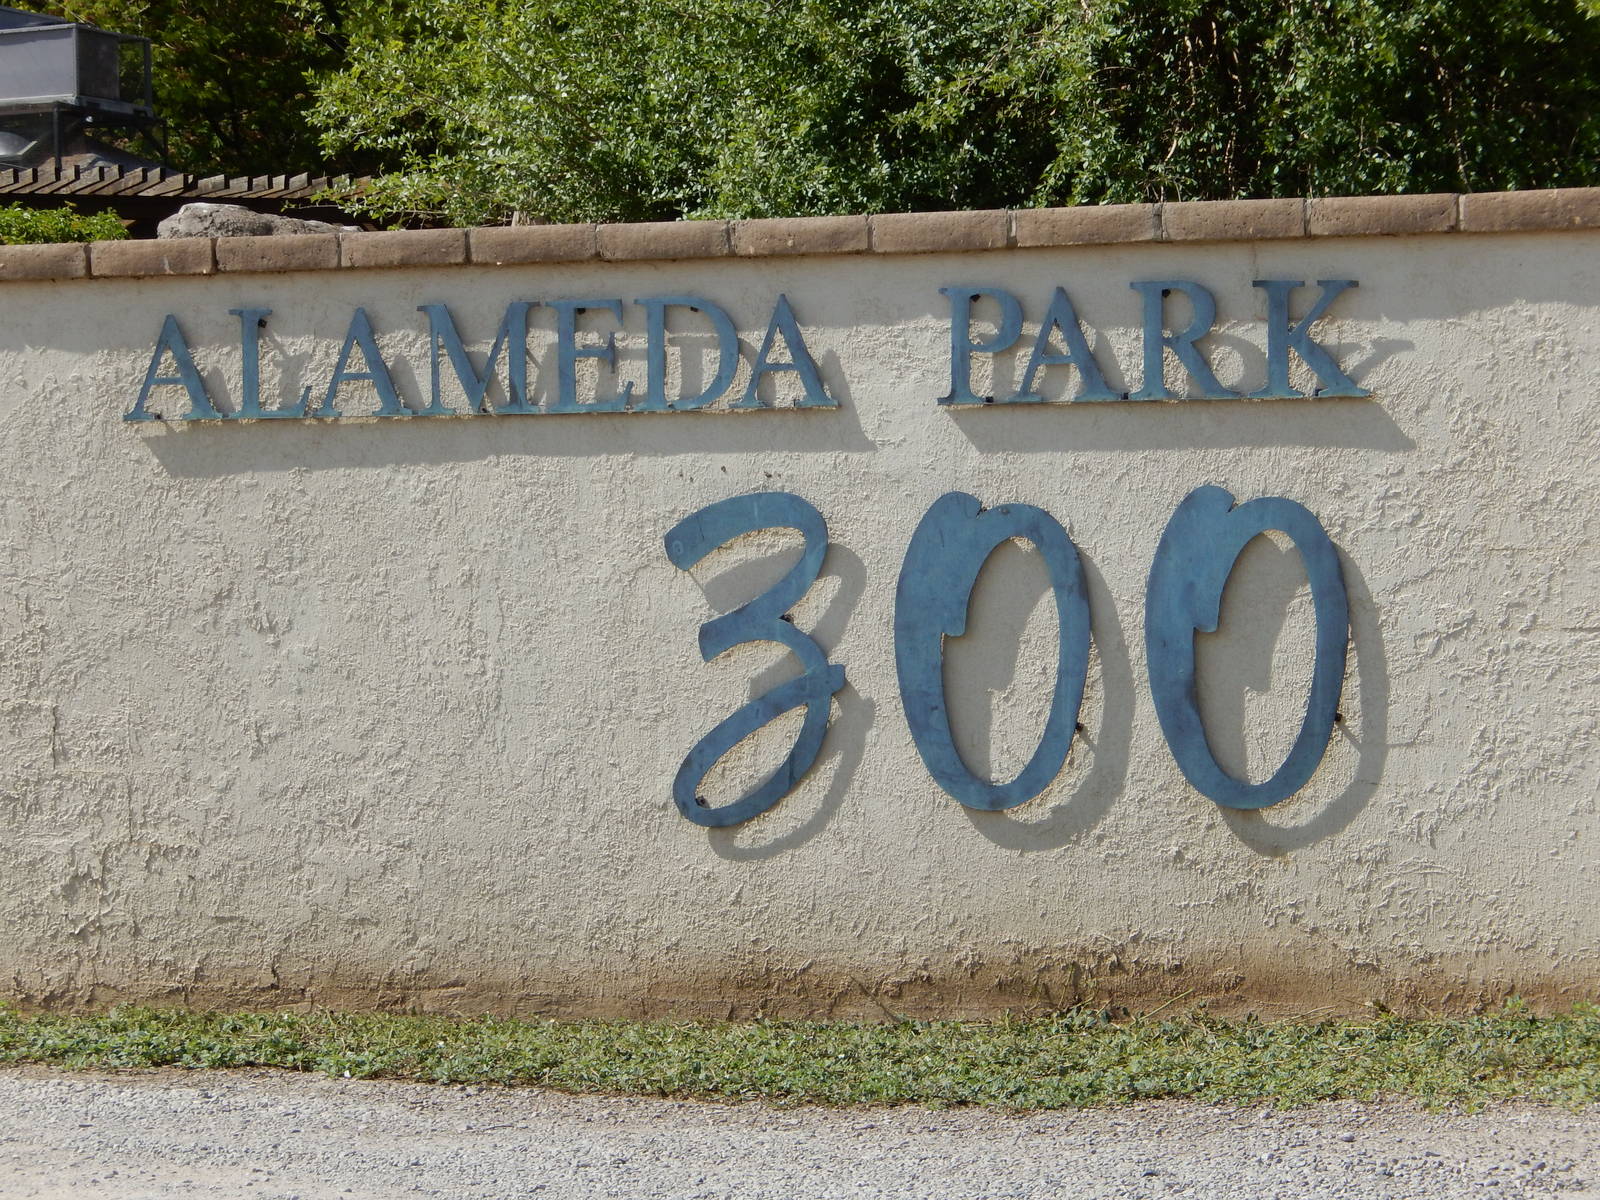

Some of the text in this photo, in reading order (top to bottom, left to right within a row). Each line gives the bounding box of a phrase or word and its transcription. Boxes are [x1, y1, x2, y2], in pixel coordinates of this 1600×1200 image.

[123, 279, 1371, 421] ALAMEDA PARK
[664, 485, 1350, 827] 300
